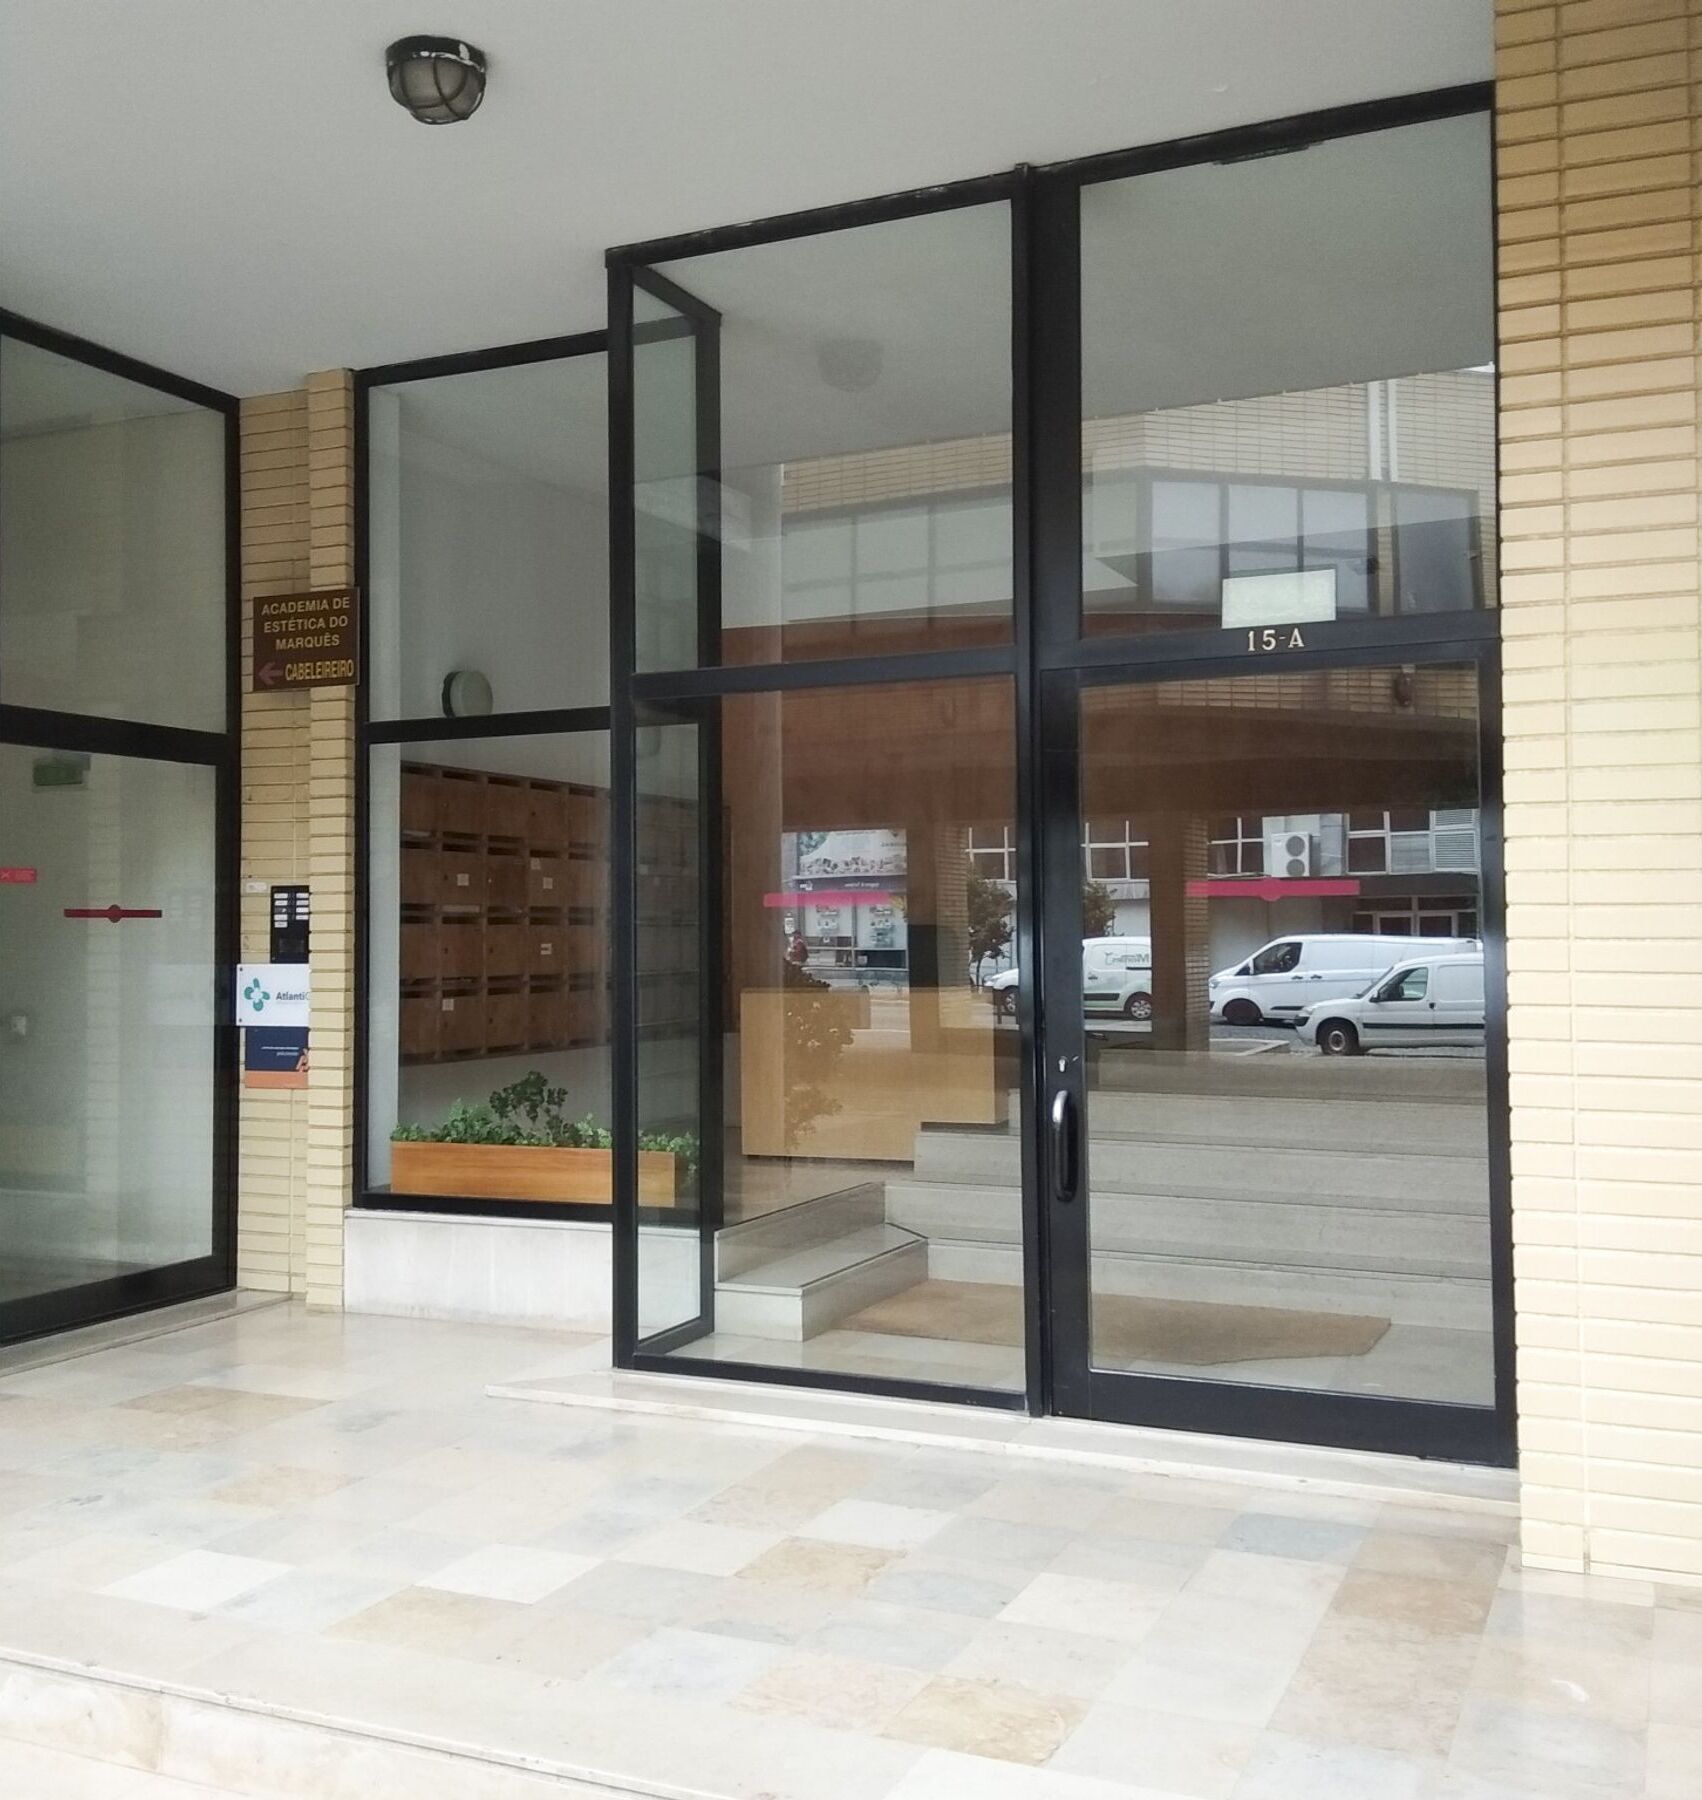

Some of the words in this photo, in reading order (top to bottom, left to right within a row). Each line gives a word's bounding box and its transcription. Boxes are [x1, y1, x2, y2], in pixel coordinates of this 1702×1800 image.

[261, 599, 329, 616] ACADEMIA
[333, 596, 350, 609] DE
[264, 617, 326, 633] ESTÉTICA
[329, 615, 348, 628] DO
[275, 632, 340, 651] MARQUÊS
[1248, 627, 1305, 652] 15-A
[285, 659, 354, 681] CABELEIREIRO
